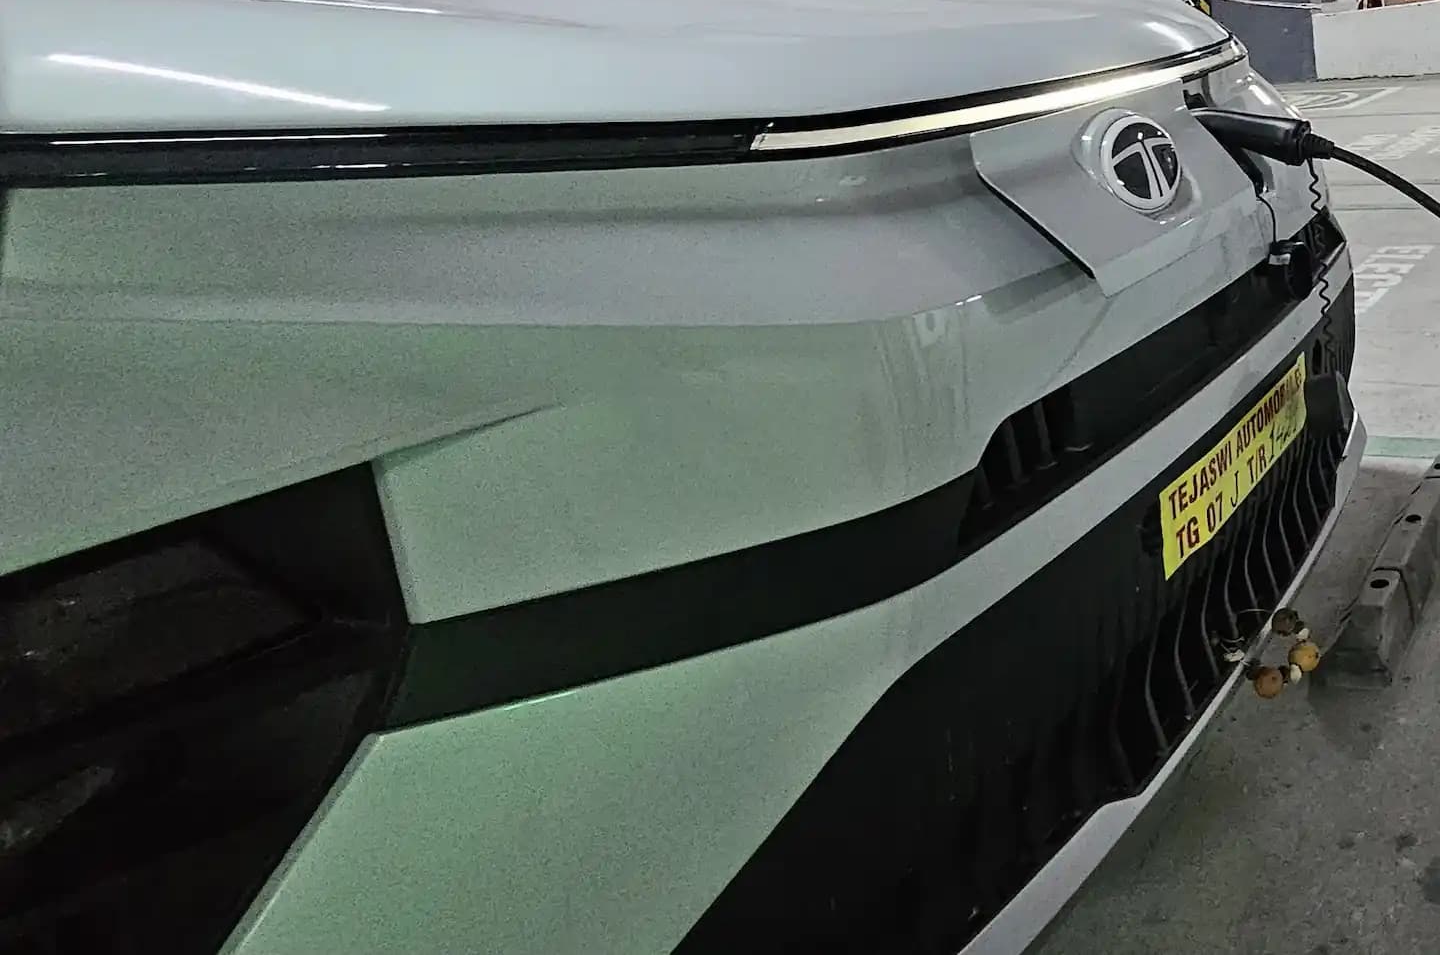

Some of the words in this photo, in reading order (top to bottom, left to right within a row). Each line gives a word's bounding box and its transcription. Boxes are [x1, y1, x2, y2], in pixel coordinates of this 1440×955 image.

[1168, 441, 1233, 521] TEJASWI
[1175, 516, 1201, 558] TG
[1206, 492, 1223, 533] 07
[1246, 444, 1267, 484] T/R
